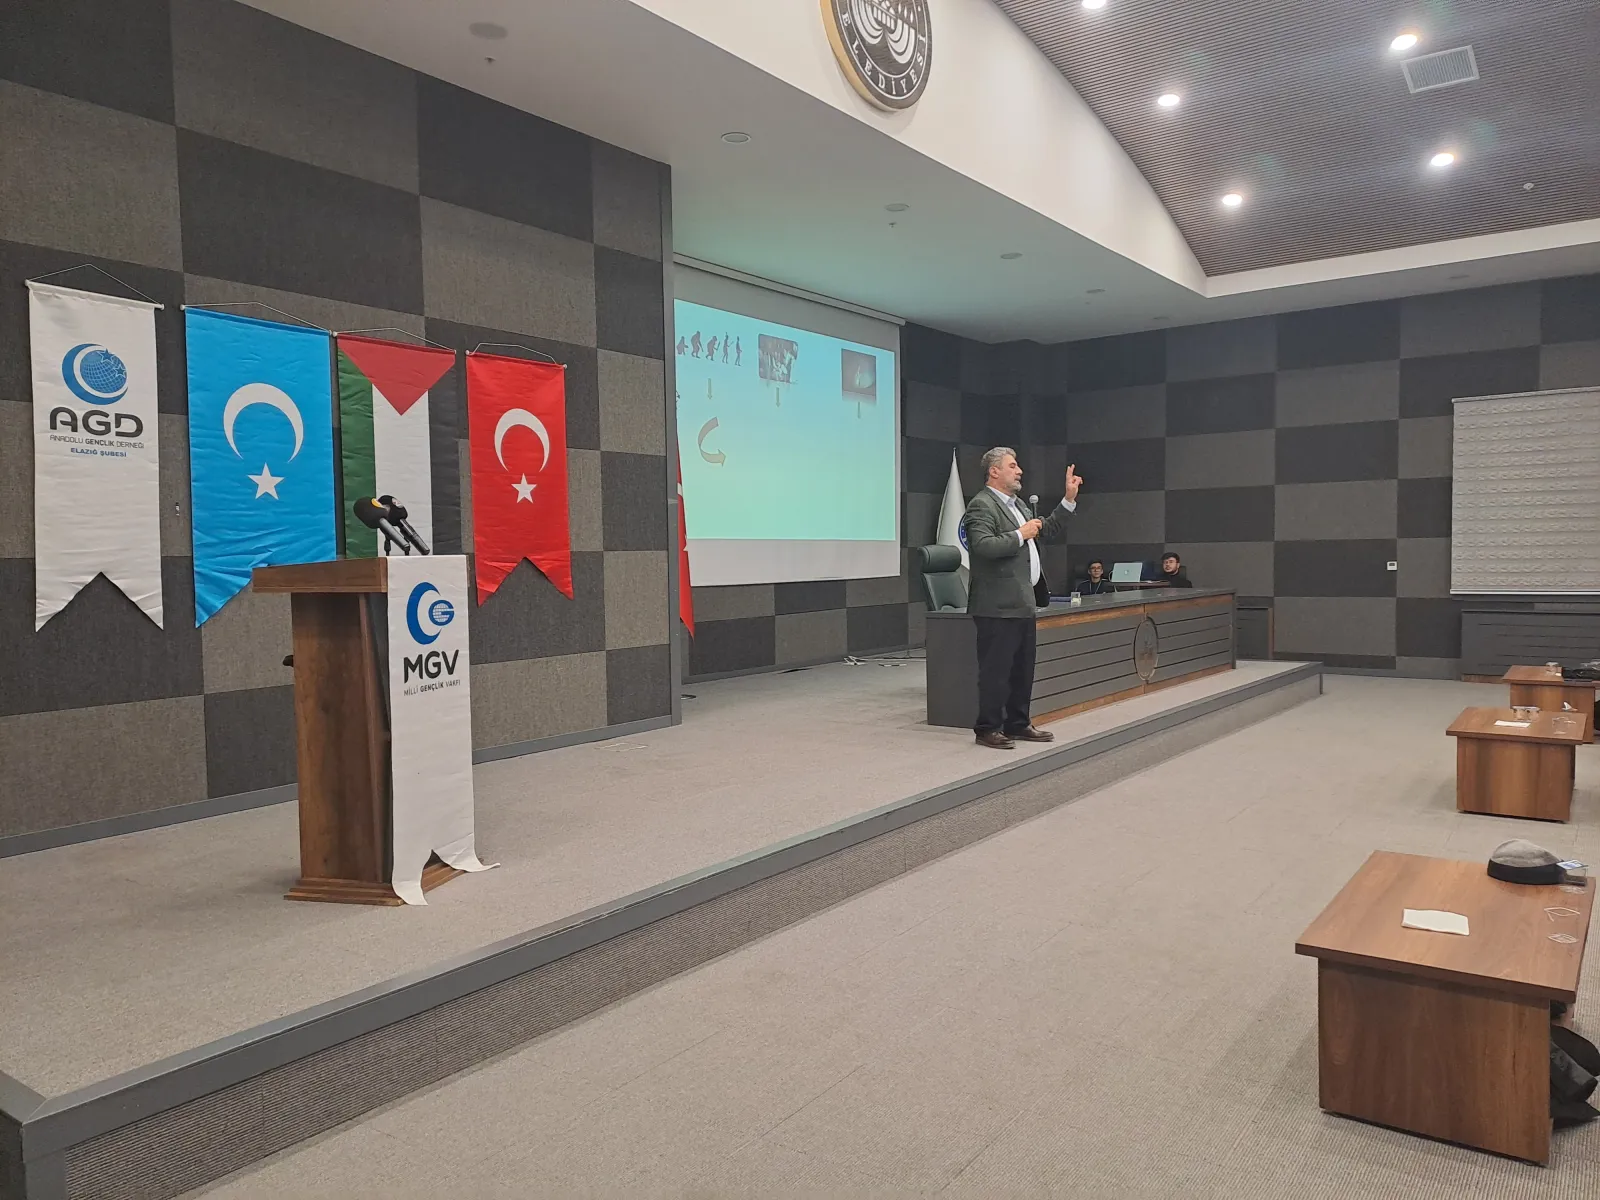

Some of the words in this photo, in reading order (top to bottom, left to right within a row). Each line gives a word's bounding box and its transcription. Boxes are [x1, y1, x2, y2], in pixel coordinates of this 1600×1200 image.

[50, 407, 143, 437] AGD
[50, 435, 83, 444] ANADOLU
[404, 649, 459, 683] MGV
[404, 686, 419, 696] MİLLİ
[420, 682, 443, 692] GENÇLİK
[445, 679, 461, 688] VAKFI
